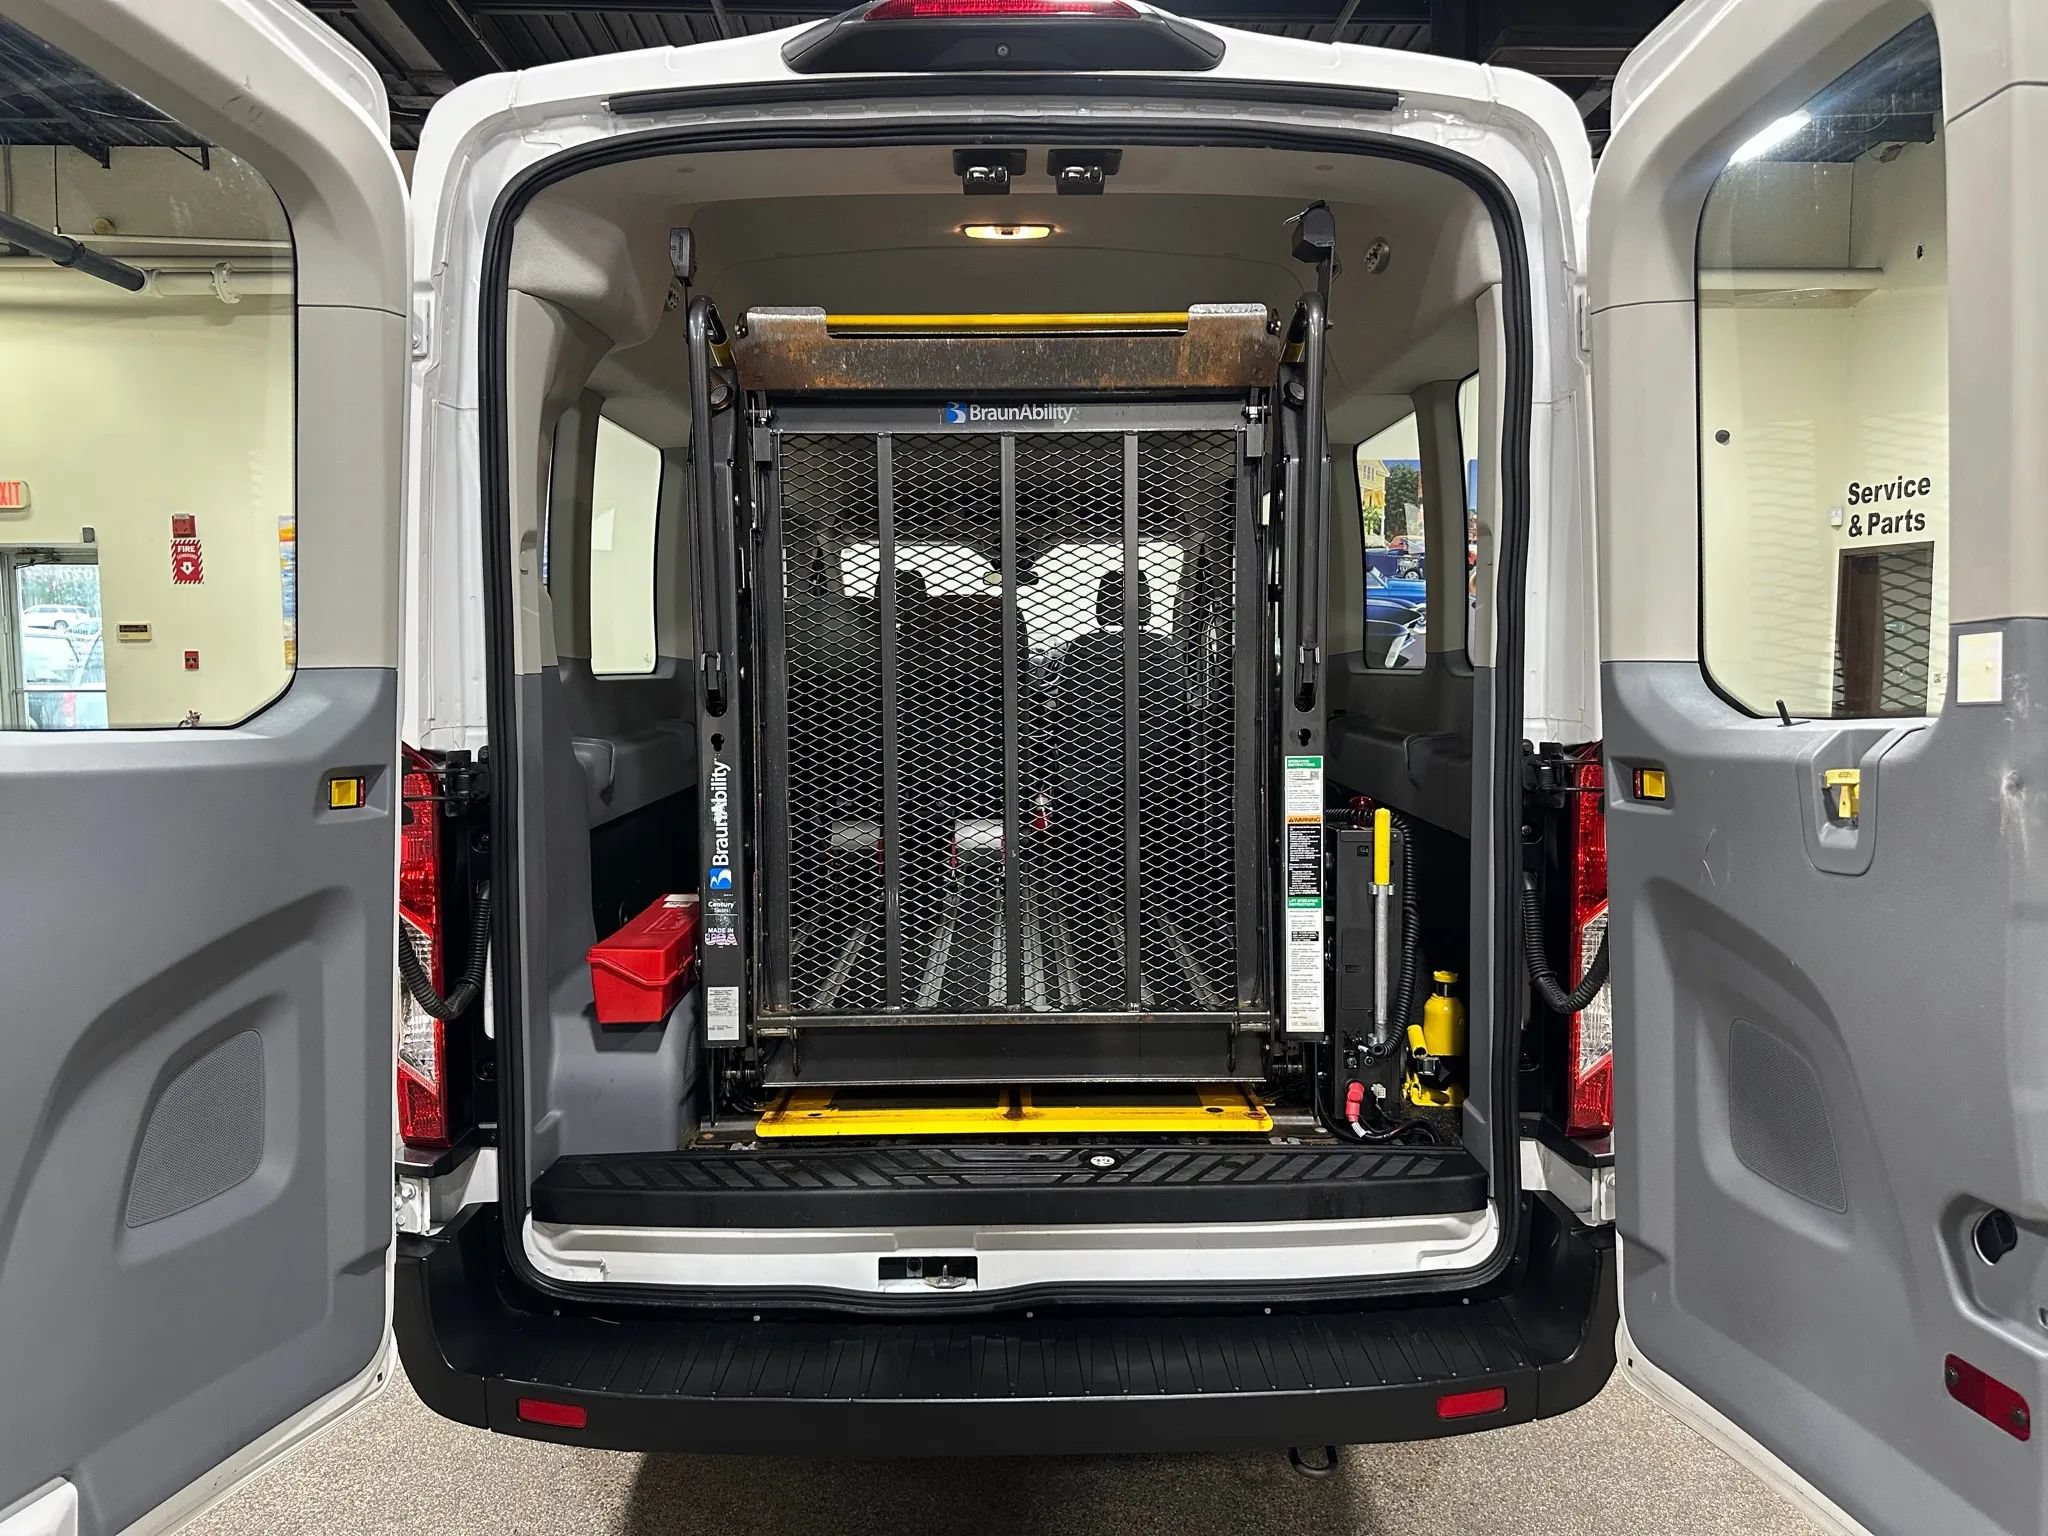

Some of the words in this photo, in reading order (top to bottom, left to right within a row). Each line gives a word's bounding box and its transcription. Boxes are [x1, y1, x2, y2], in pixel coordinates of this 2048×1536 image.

[970, 404, 1073, 424] BraunAbility
[0, 482, 20, 505] XIT
[1847, 475, 1931, 505] Service
[1848, 514, 1863, 537] &
[1867, 509, 1926, 535] Parts
[177, 545, 196, 553] FIRE
[711, 758, 732, 866] BraunAbility
[708, 901, 735, 909] Century
[704, 933, 738, 946] USA
